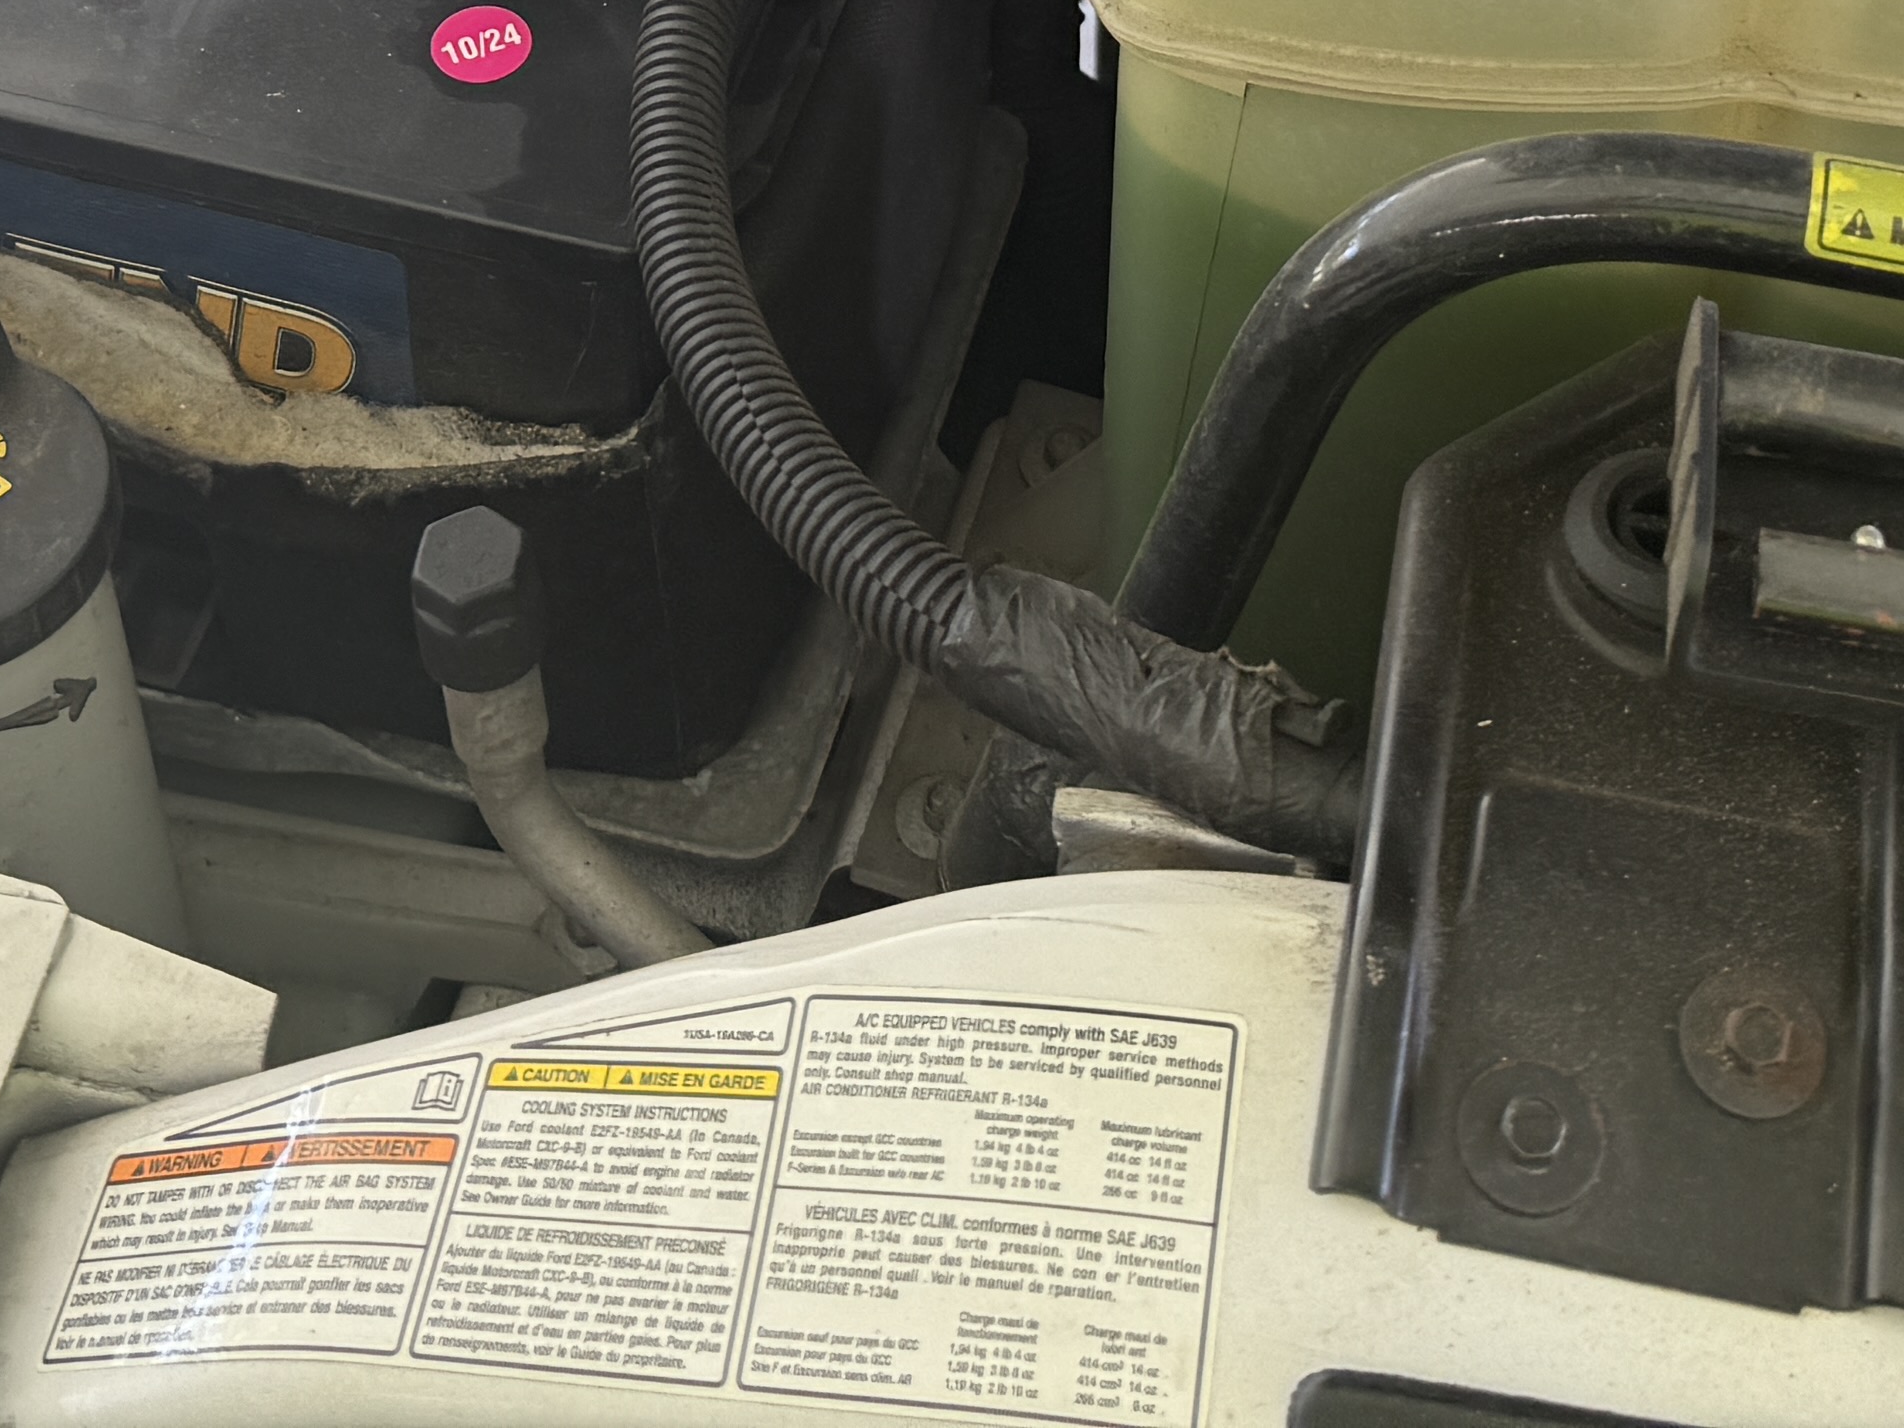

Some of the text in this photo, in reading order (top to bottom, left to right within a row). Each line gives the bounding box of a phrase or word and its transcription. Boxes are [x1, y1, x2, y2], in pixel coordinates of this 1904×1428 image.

[440, 22, 523, 66] 10/24
[855, 1012, 1177, 1050] A/C EQUIPPED VEHICLES comply with SAE J639
[895, 1034, 930, 1047] under
[937, 1035, 965, 1051] high
[1041, 1042, 1100, 1060] Improper
[1108, 1050, 1157, 1066] service
[1165, 1055, 1224, 1073] methods
[522, 1068, 591, 1084] CAUTION
[639, 1072, 766, 1090] MISE EN GARDE
[807, 1050, 830, 1063] may
[836, 1051, 872, 1063] cause
[919, 1052, 964, 1067] System
[987, 1057, 1003, 1069] be
[1009, 1059, 1064, 1075] serviced
[1070, 1061, 1084, 1078] by
[1090, 1066, 1149, 1083] qualified
[1154, 1072, 1222, 1091] personnel
[801, 1083, 822, 1095] AIR
[826, 1084, 908, 1099] CONDITIONER
[911, 1087, 998, 1105] REFRIGERANT
[522, 1101, 728, 1123] COOLING SYSTEM INSTRUCTIONS
[148, 1151, 224, 1174] WARNING
[805, 1201, 1176, 1252] VÉHICULES AVEC CLIM. conformes à norme SAE J639
